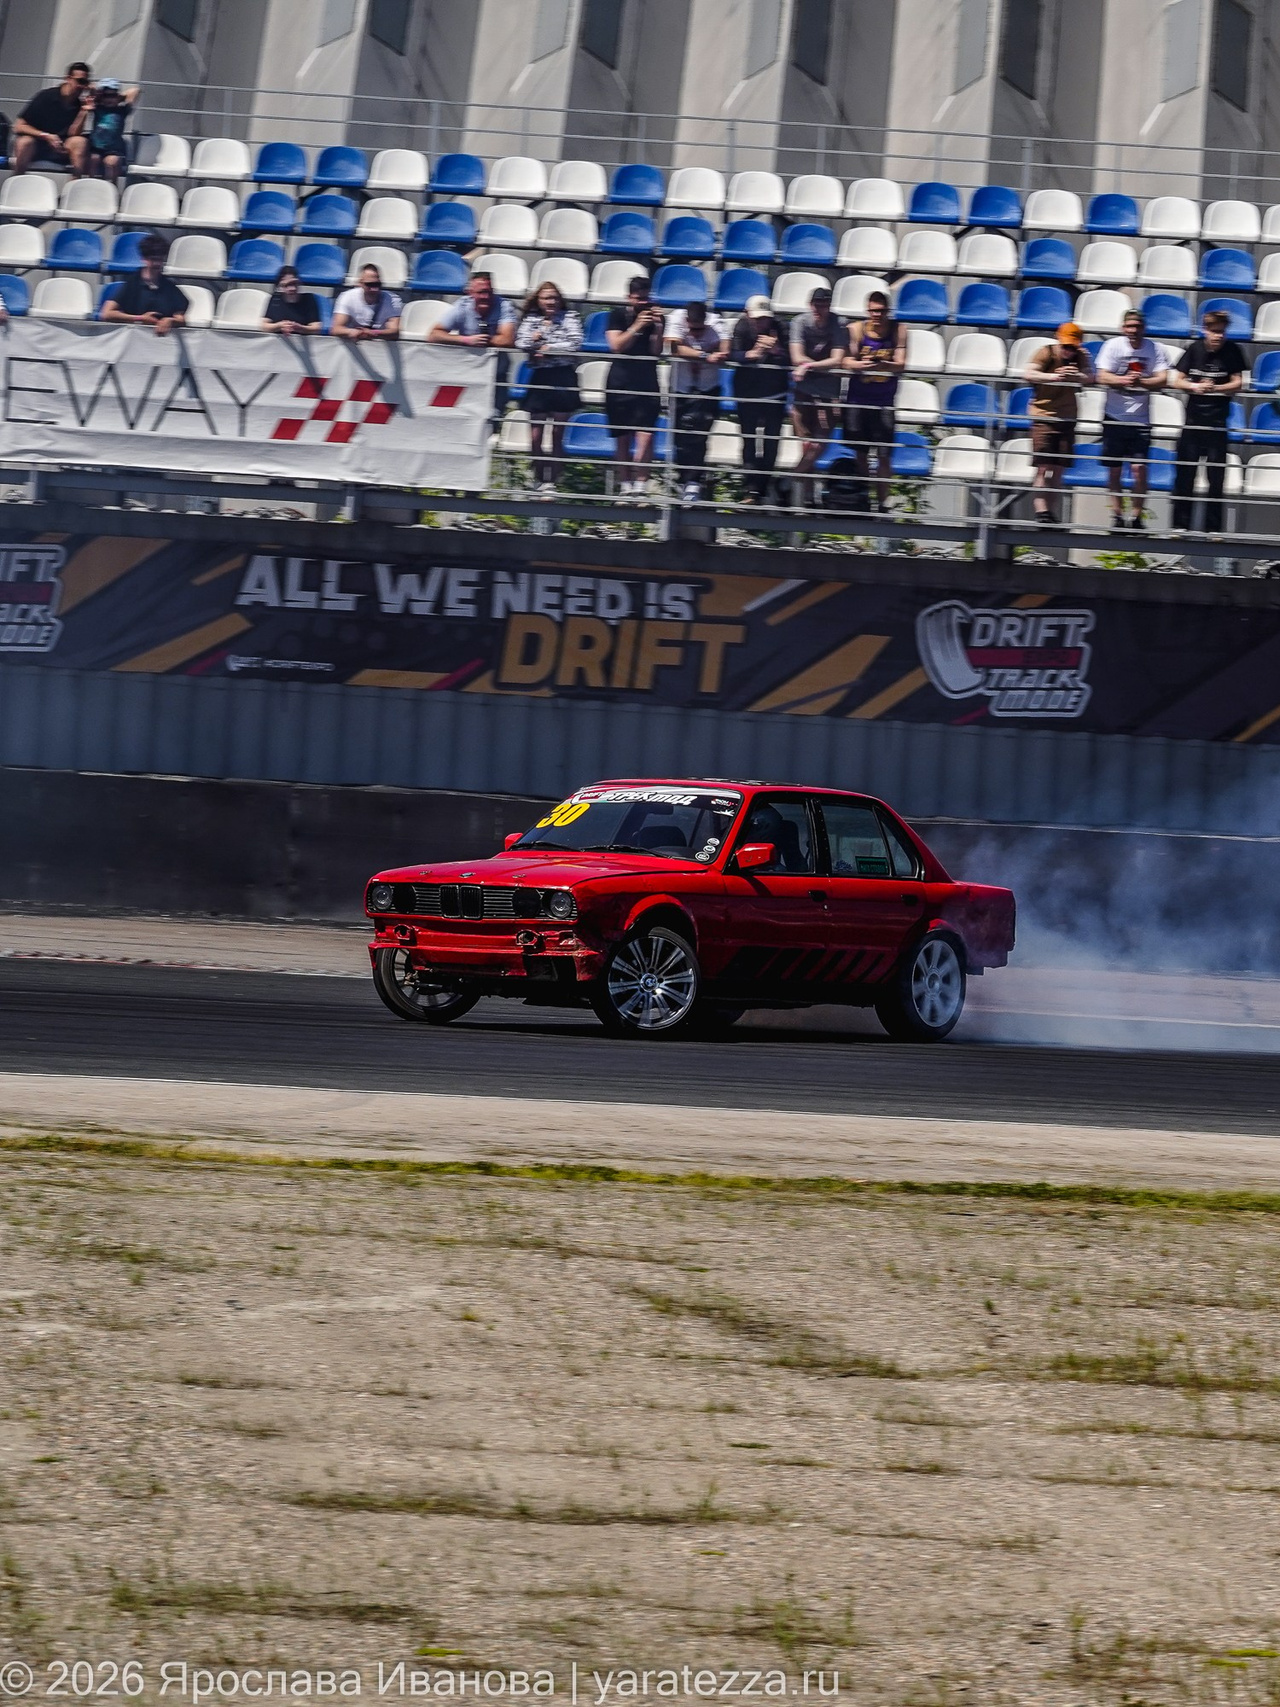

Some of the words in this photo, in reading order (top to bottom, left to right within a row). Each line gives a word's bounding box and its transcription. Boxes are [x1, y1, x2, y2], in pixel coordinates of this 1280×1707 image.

[4, 356, 280, 437] EWAY
[234, 555, 362, 611] ALL
[373, 563, 482, 617] WE
[490, 570, 635, 625] NEED
[643, 581, 698, 621] IS
[498, 614, 746, 693] DRIFT
[968, 616, 1086, 647] DRIFT
[536, 803, 590, 828] 30
